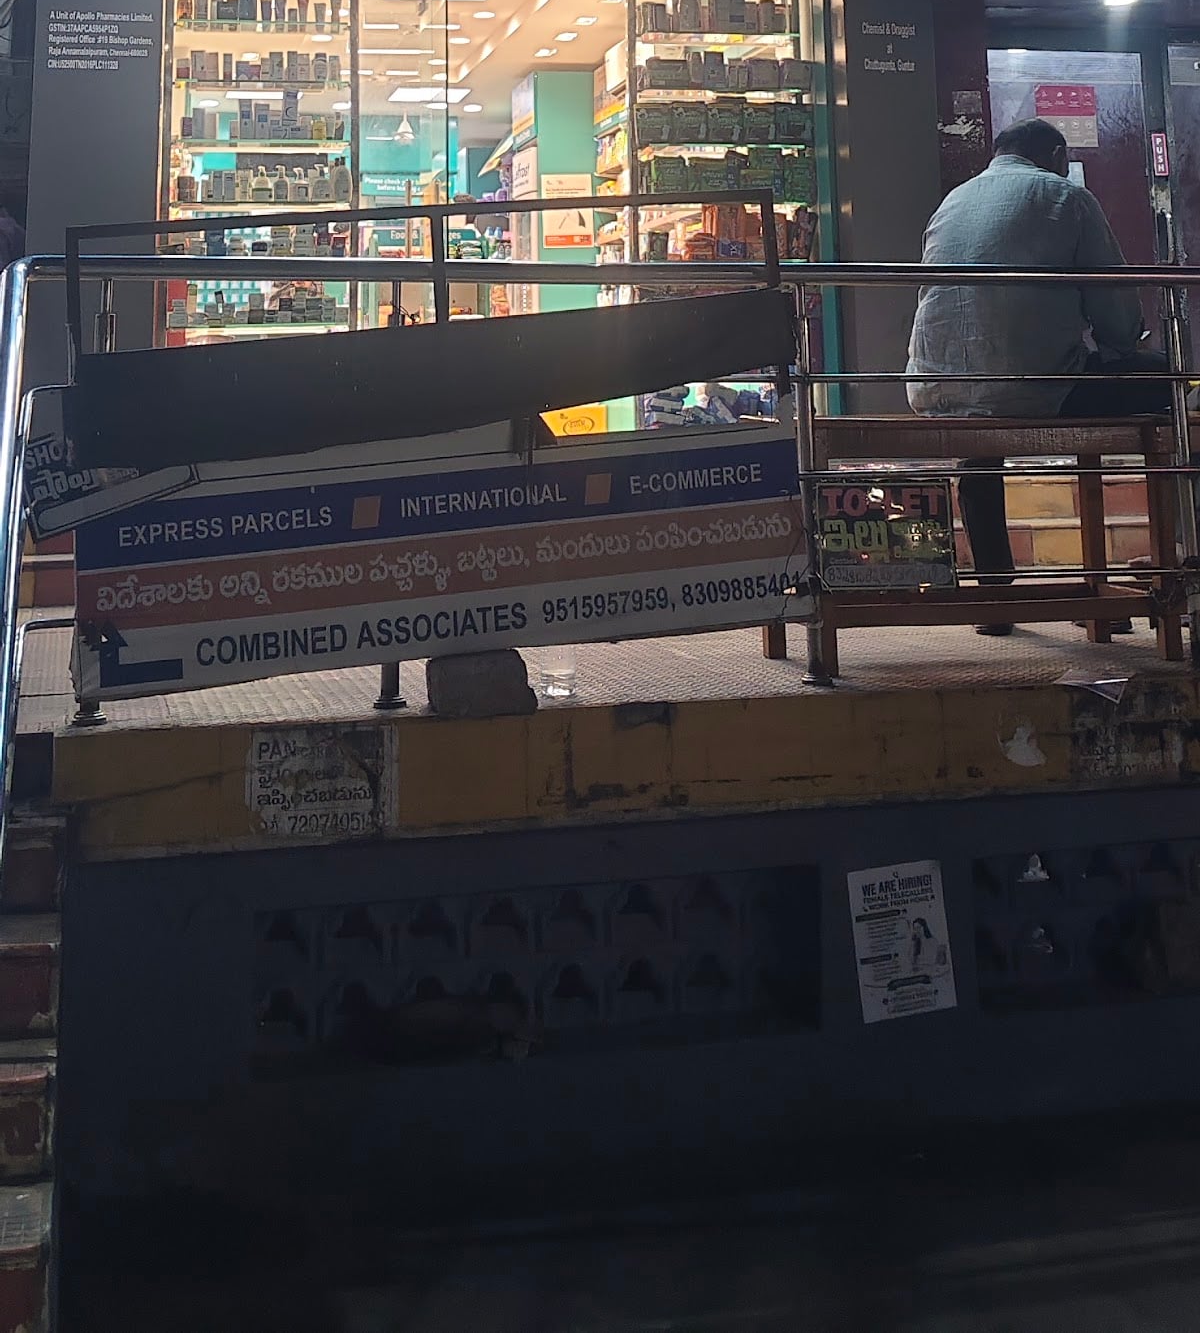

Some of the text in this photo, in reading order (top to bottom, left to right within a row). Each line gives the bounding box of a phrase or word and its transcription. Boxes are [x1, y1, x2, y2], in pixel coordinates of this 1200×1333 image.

[49, 10, 55, 20] A
[56, 11, 69, 20] Unit
[69, 11, 76, 20] of
[76, 11, 95, 21] Apollo
[96, 12, 130, 21] Pharmacies
[48, 34, 78, 45] Registered
[79, 34, 96, 44] Office
[109, 35, 128, 46] Bishop
[862, 22, 916, 38] Chemist & Druggist
[48, 46, 61, 56] Raja
[1155, 137, 1165, 173] PUSH
[390, 230, 408, 240] Foo
[118, 463, 762, 548] EXPRESS PARCELS INTERNATIONAL E-COMMERCE
[96, 574, 213, 612] విదేశాలకు
[219, 570, 272, 605] అన్ని
[273, 561, 363, 592] రకముల
[535, 532, 630, 563] మందులు
[196, 623, 347, 667] COMBINED
[356, 602, 528, 651] ASSOCIATES
[542, 586, 676, 624] 9515957959,
[258, 739, 296, 760] PAN
[861, 874, 933, 897] WE ARE HIRING!
